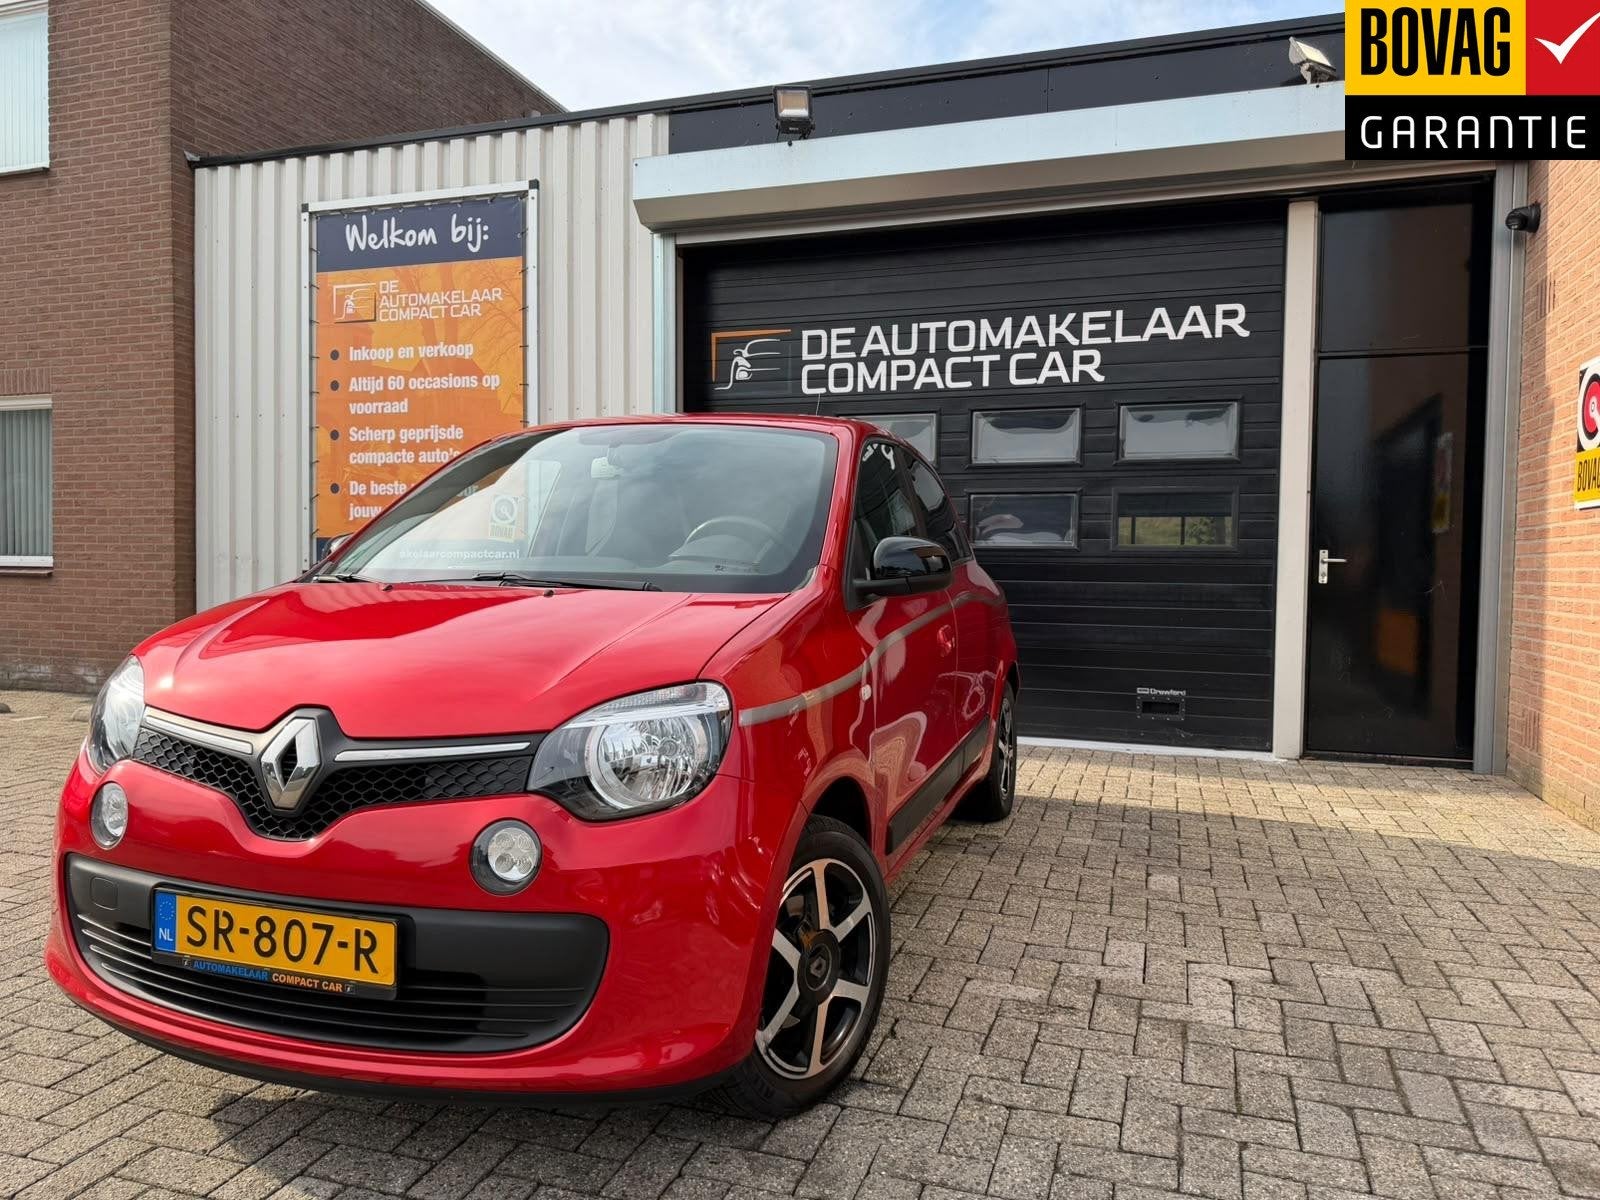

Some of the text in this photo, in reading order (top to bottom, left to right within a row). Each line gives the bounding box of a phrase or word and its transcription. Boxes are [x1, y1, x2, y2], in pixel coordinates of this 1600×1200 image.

[345, 213, 489, 253] Welkom bij:
[379, 280, 399, 294] DE
[379, 287, 503, 309] AUTOMAKELAAR
[379, 304, 482, 322] COMPACT CAR
[801, 303, 1251, 361] DE AUTOMAKELAAR
[349, 342, 474, 363] Inkoop en verkoop
[801, 348, 1105, 395] COMPACT CAR
[349, 374, 500, 394] Altijd 60 occasions op
[349, 399, 408, 414] voorraad
[349, 425, 464, 444] Scherp geprijsde
[349, 449, 413, 466] compacte
[349, 480, 407, 496] De beste
[399, 548, 520, 561] akelaarcompactcar.nl
[158, 905, 379, 974] NL SR-807-R
[192, 960, 343, 992] AUTOMAKELAAR COMPACT CAR
